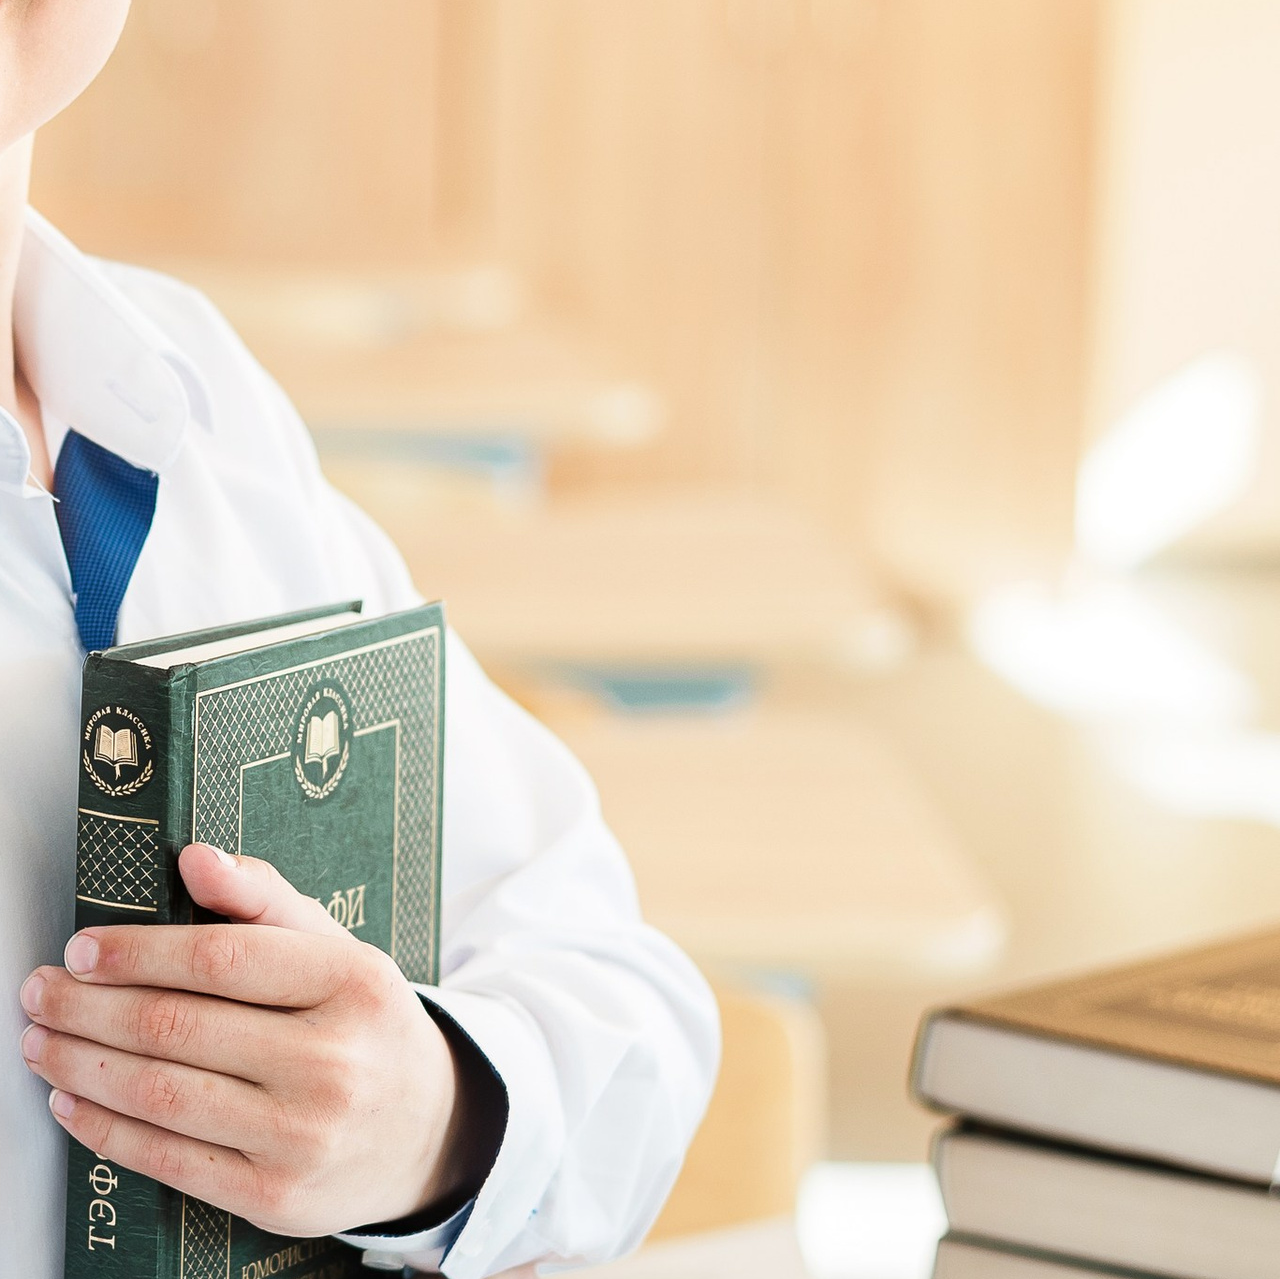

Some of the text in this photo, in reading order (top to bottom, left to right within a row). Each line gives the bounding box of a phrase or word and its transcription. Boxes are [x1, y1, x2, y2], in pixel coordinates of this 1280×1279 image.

[84, 705, 152, 750] МИРОВАЯ КЛАССИКА
[317, 884, 366, 930] ФИ
[88, 1152, 118, 1251] ТЭФ
